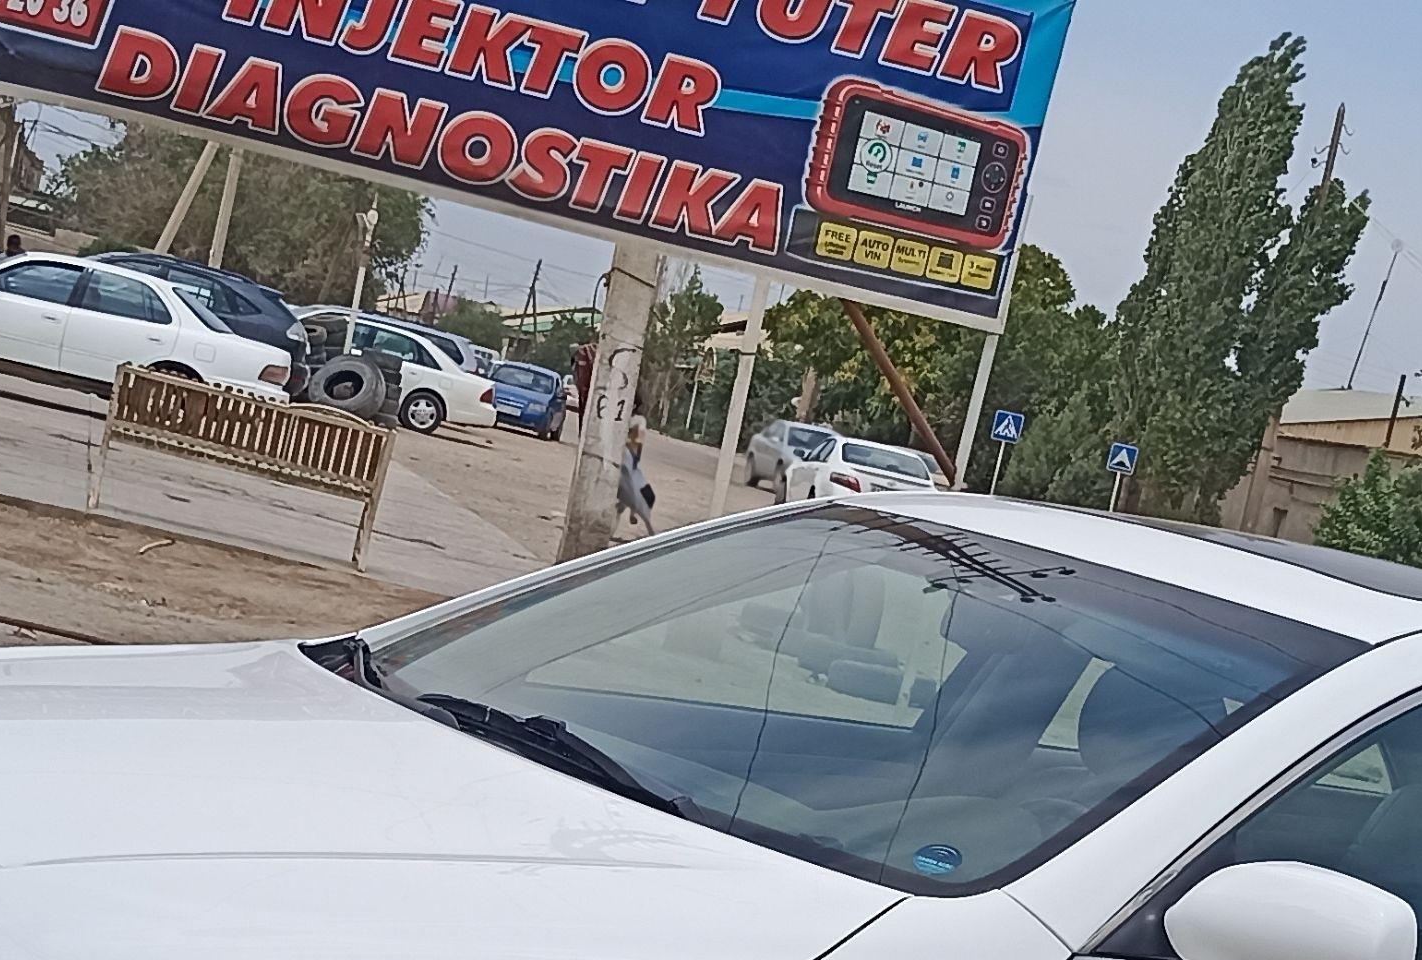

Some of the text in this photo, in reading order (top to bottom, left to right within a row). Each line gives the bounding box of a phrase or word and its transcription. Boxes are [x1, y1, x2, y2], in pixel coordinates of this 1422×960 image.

[52, 0, 88, 27] 36
[94, 25, 782, 256] DIAGNOSTIKA
[825, 229, 852, 243] FREE
[860, 237, 890, 252] AUTO
[864, 249, 881, 261] VIN
[895, 245, 927, 259] MULTI
